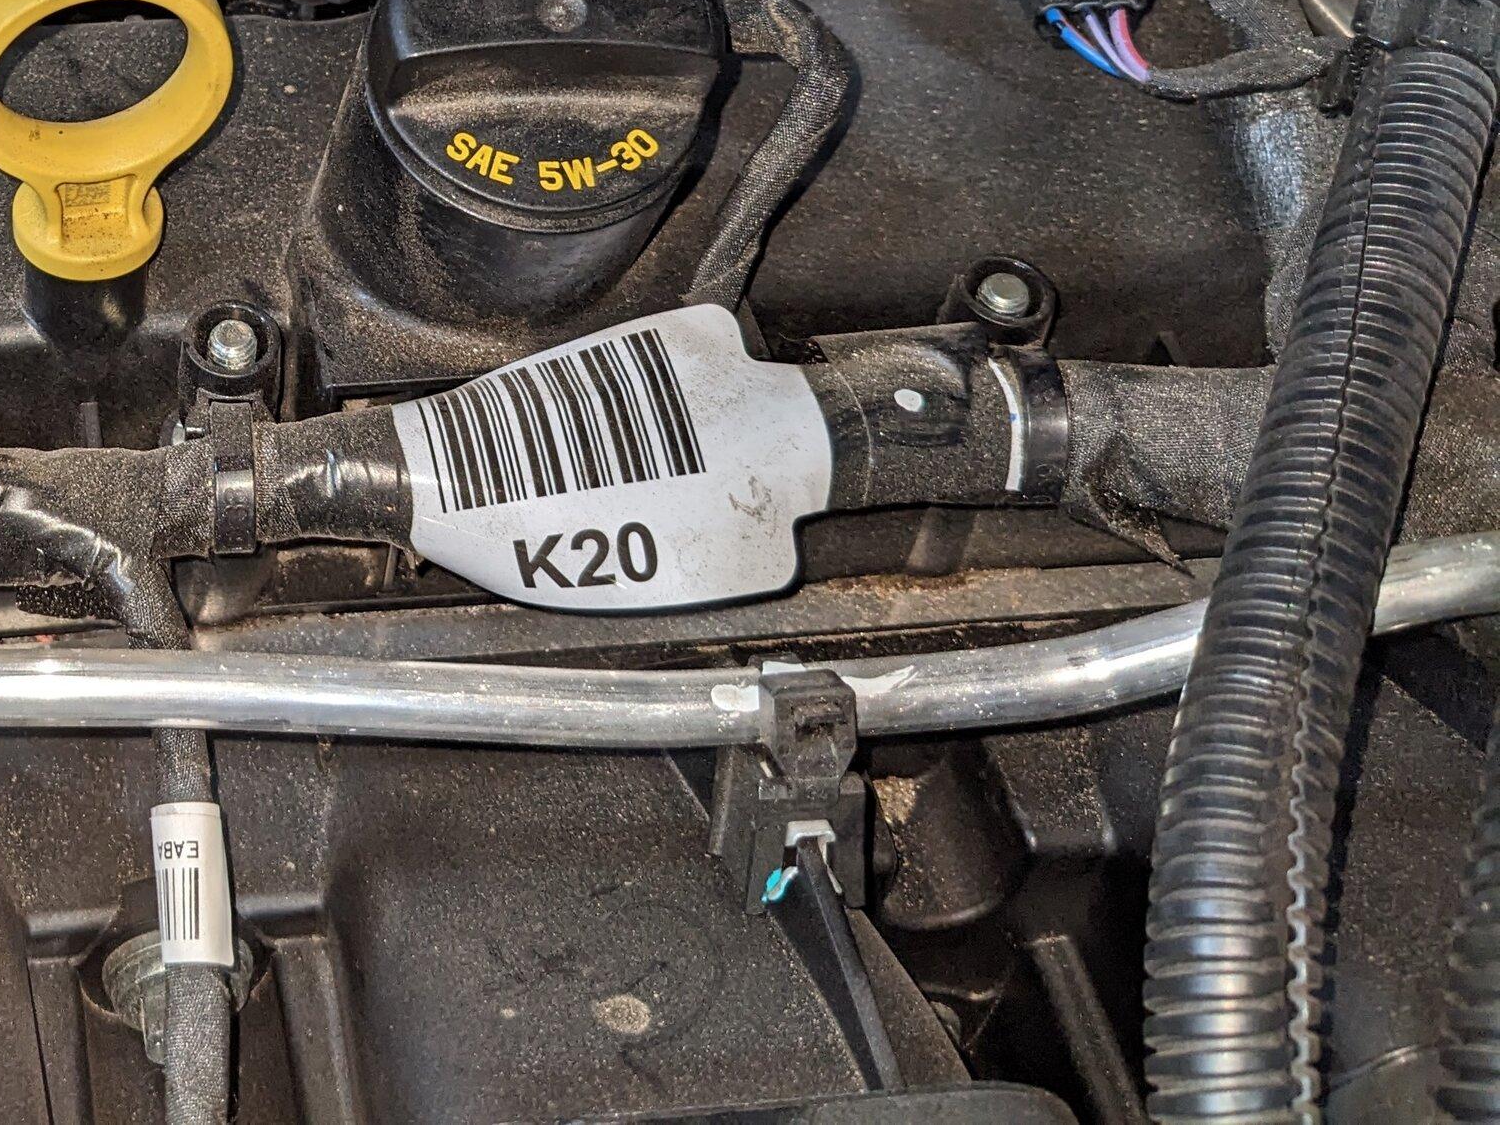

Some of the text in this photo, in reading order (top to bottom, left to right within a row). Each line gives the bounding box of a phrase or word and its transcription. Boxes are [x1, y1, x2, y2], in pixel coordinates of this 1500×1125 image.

[445, 127, 660, 192] SAE 5W-30
[512, 521, 659, 589] K20
